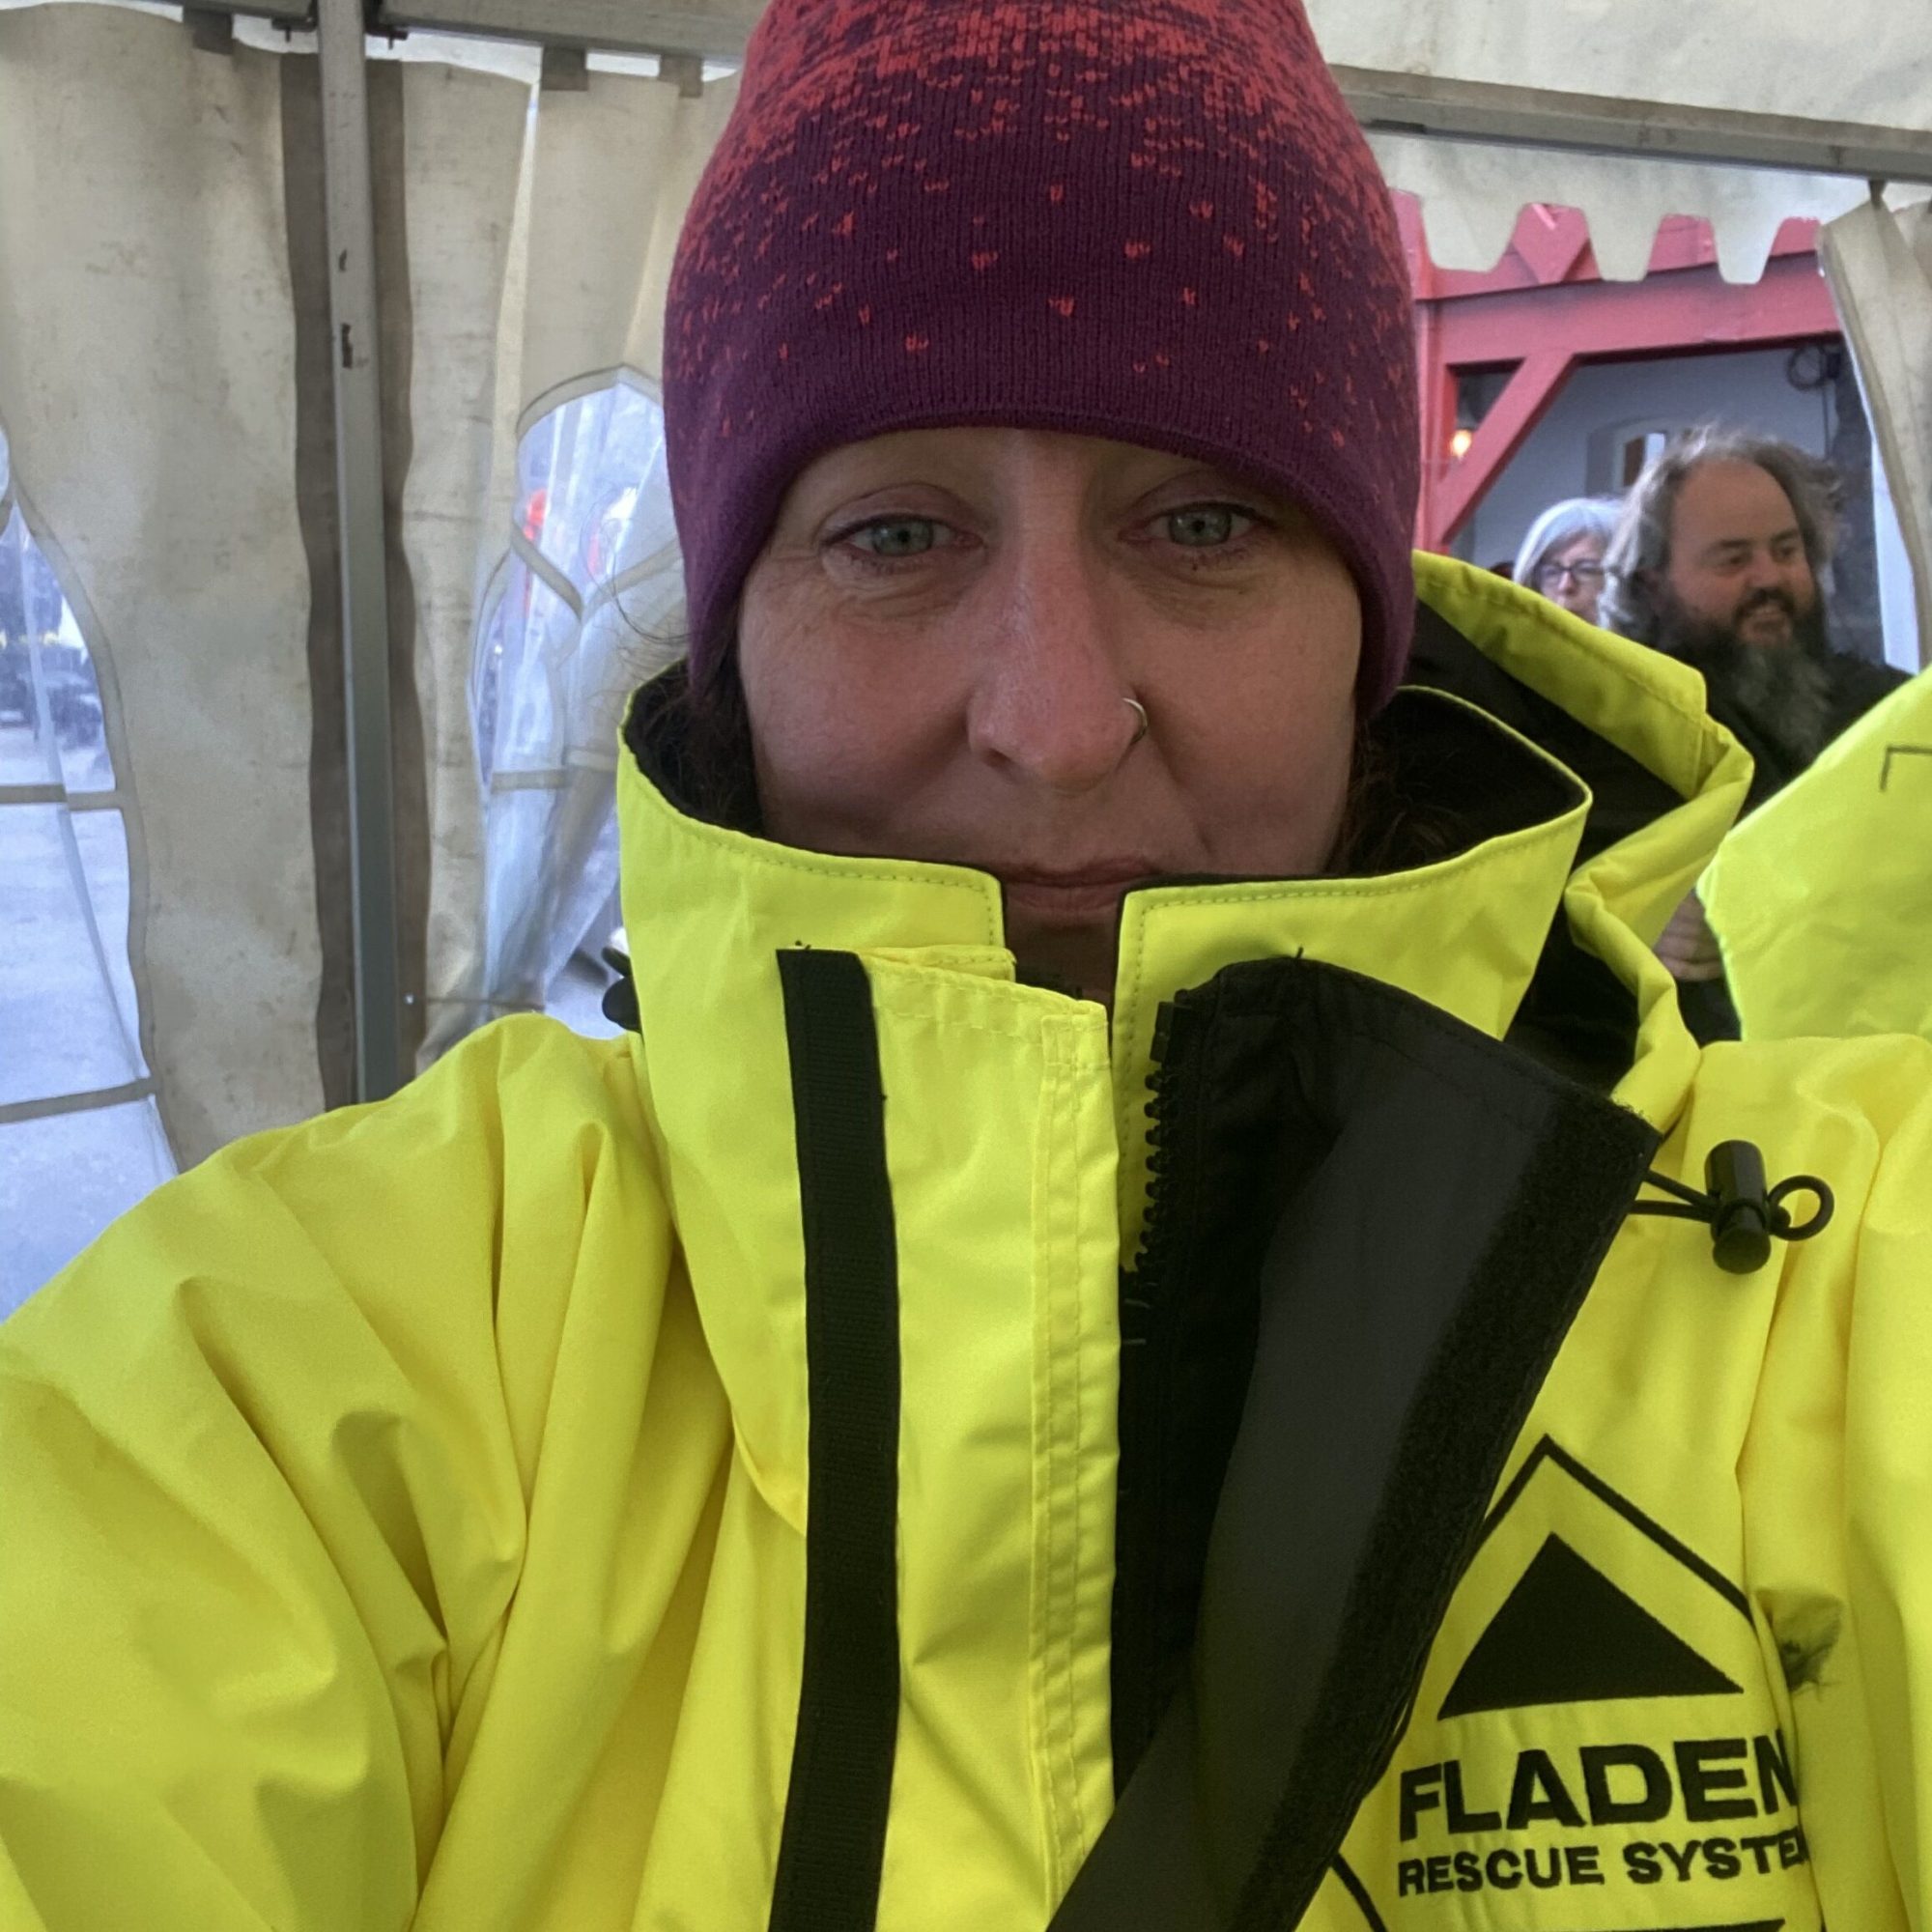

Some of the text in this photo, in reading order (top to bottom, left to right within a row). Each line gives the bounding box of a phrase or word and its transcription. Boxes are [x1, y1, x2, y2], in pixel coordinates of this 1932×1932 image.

[1399, 1728, 1799, 1842] FLADEN
[1399, 1826, 1809, 1897] RESCUE SYSTE
